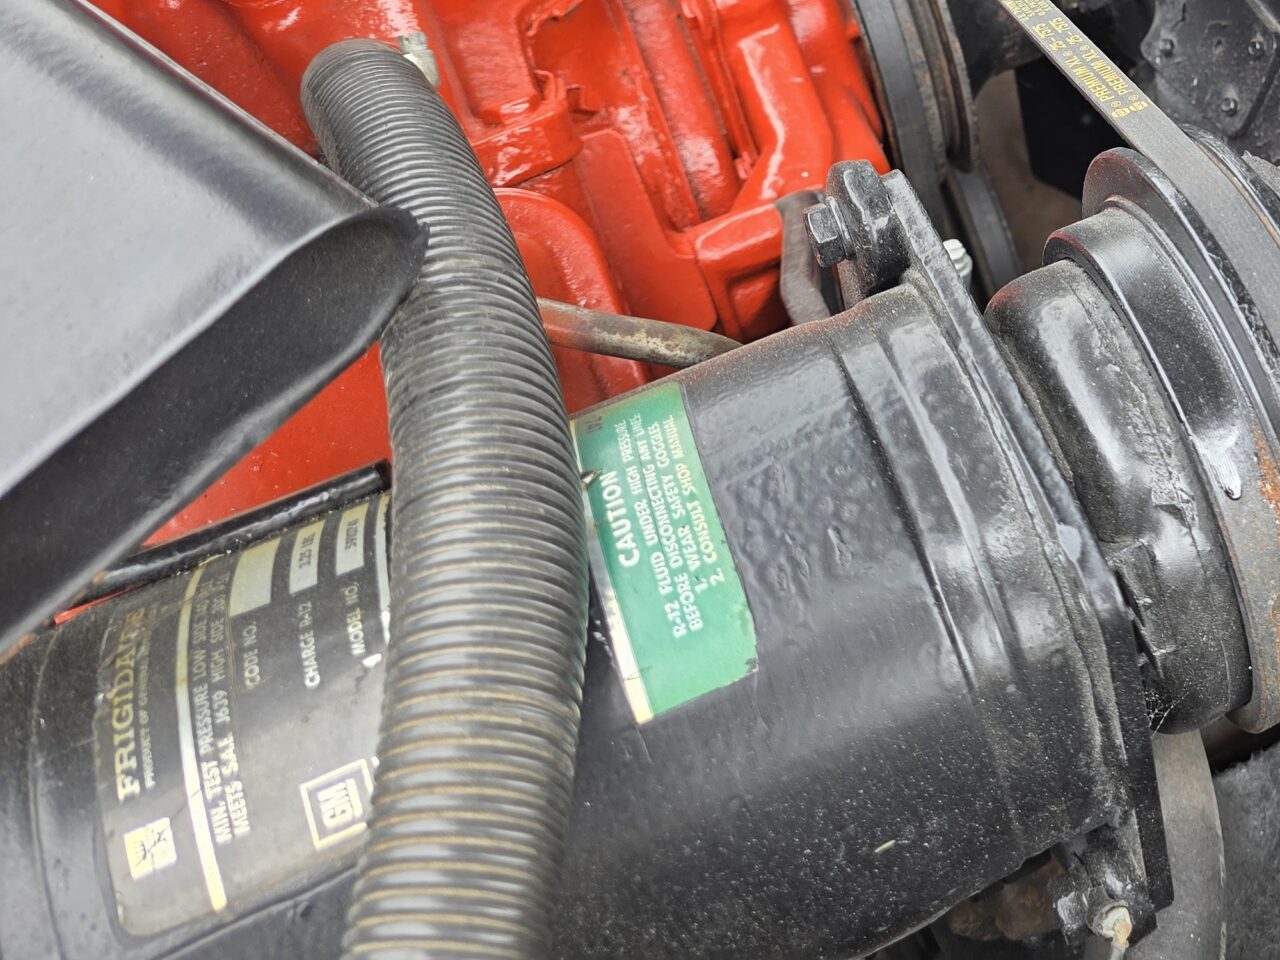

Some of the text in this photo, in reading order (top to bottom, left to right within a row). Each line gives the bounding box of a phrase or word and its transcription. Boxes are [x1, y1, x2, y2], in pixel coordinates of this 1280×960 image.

[1072, 64, 1115, 102] PREMIUM
[1090, 58, 1133, 95] PREMIUM
[625, 464, 643, 494] HIGH
[661, 472, 685, 518] SAFETY
[676, 461, 696, 495] SHOP
[598, 469, 641, 568] CAUTION
[633, 498, 659, 545] UNDER
[640, 463, 684, 568] DISCONNECTING
[688, 499, 717, 563] CONSULT
[677, 524, 702, 571] WEAR
[648, 550, 674, 595] FLUID
[708, 567, 725, 585] 2.
[298, 600, 312, 627] R-12
[663, 599, 688, 638] R-12
[673, 571, 703, 631] BEFORE
[210, 618, 224, 643] SIDE
[345, 608, 366, 655] MODEL
[193, 648, 206, 680] LOW
[210, 648, 225, 682] HIGH
[239, 620, 262, 688] CODE NO.
[302, 630, 322, 688] CHARGE
[137, 708, 149, 723] OF
[192, 683, 214, 755] PRESSURE
[211, 689, 230, 724] J639
[141, 728, 156, 788] PRODUCT
[201, 760, 222, 800] TEST
[224, 779, 250, 835] MEETS
[316, 781, 354, 827] GM
